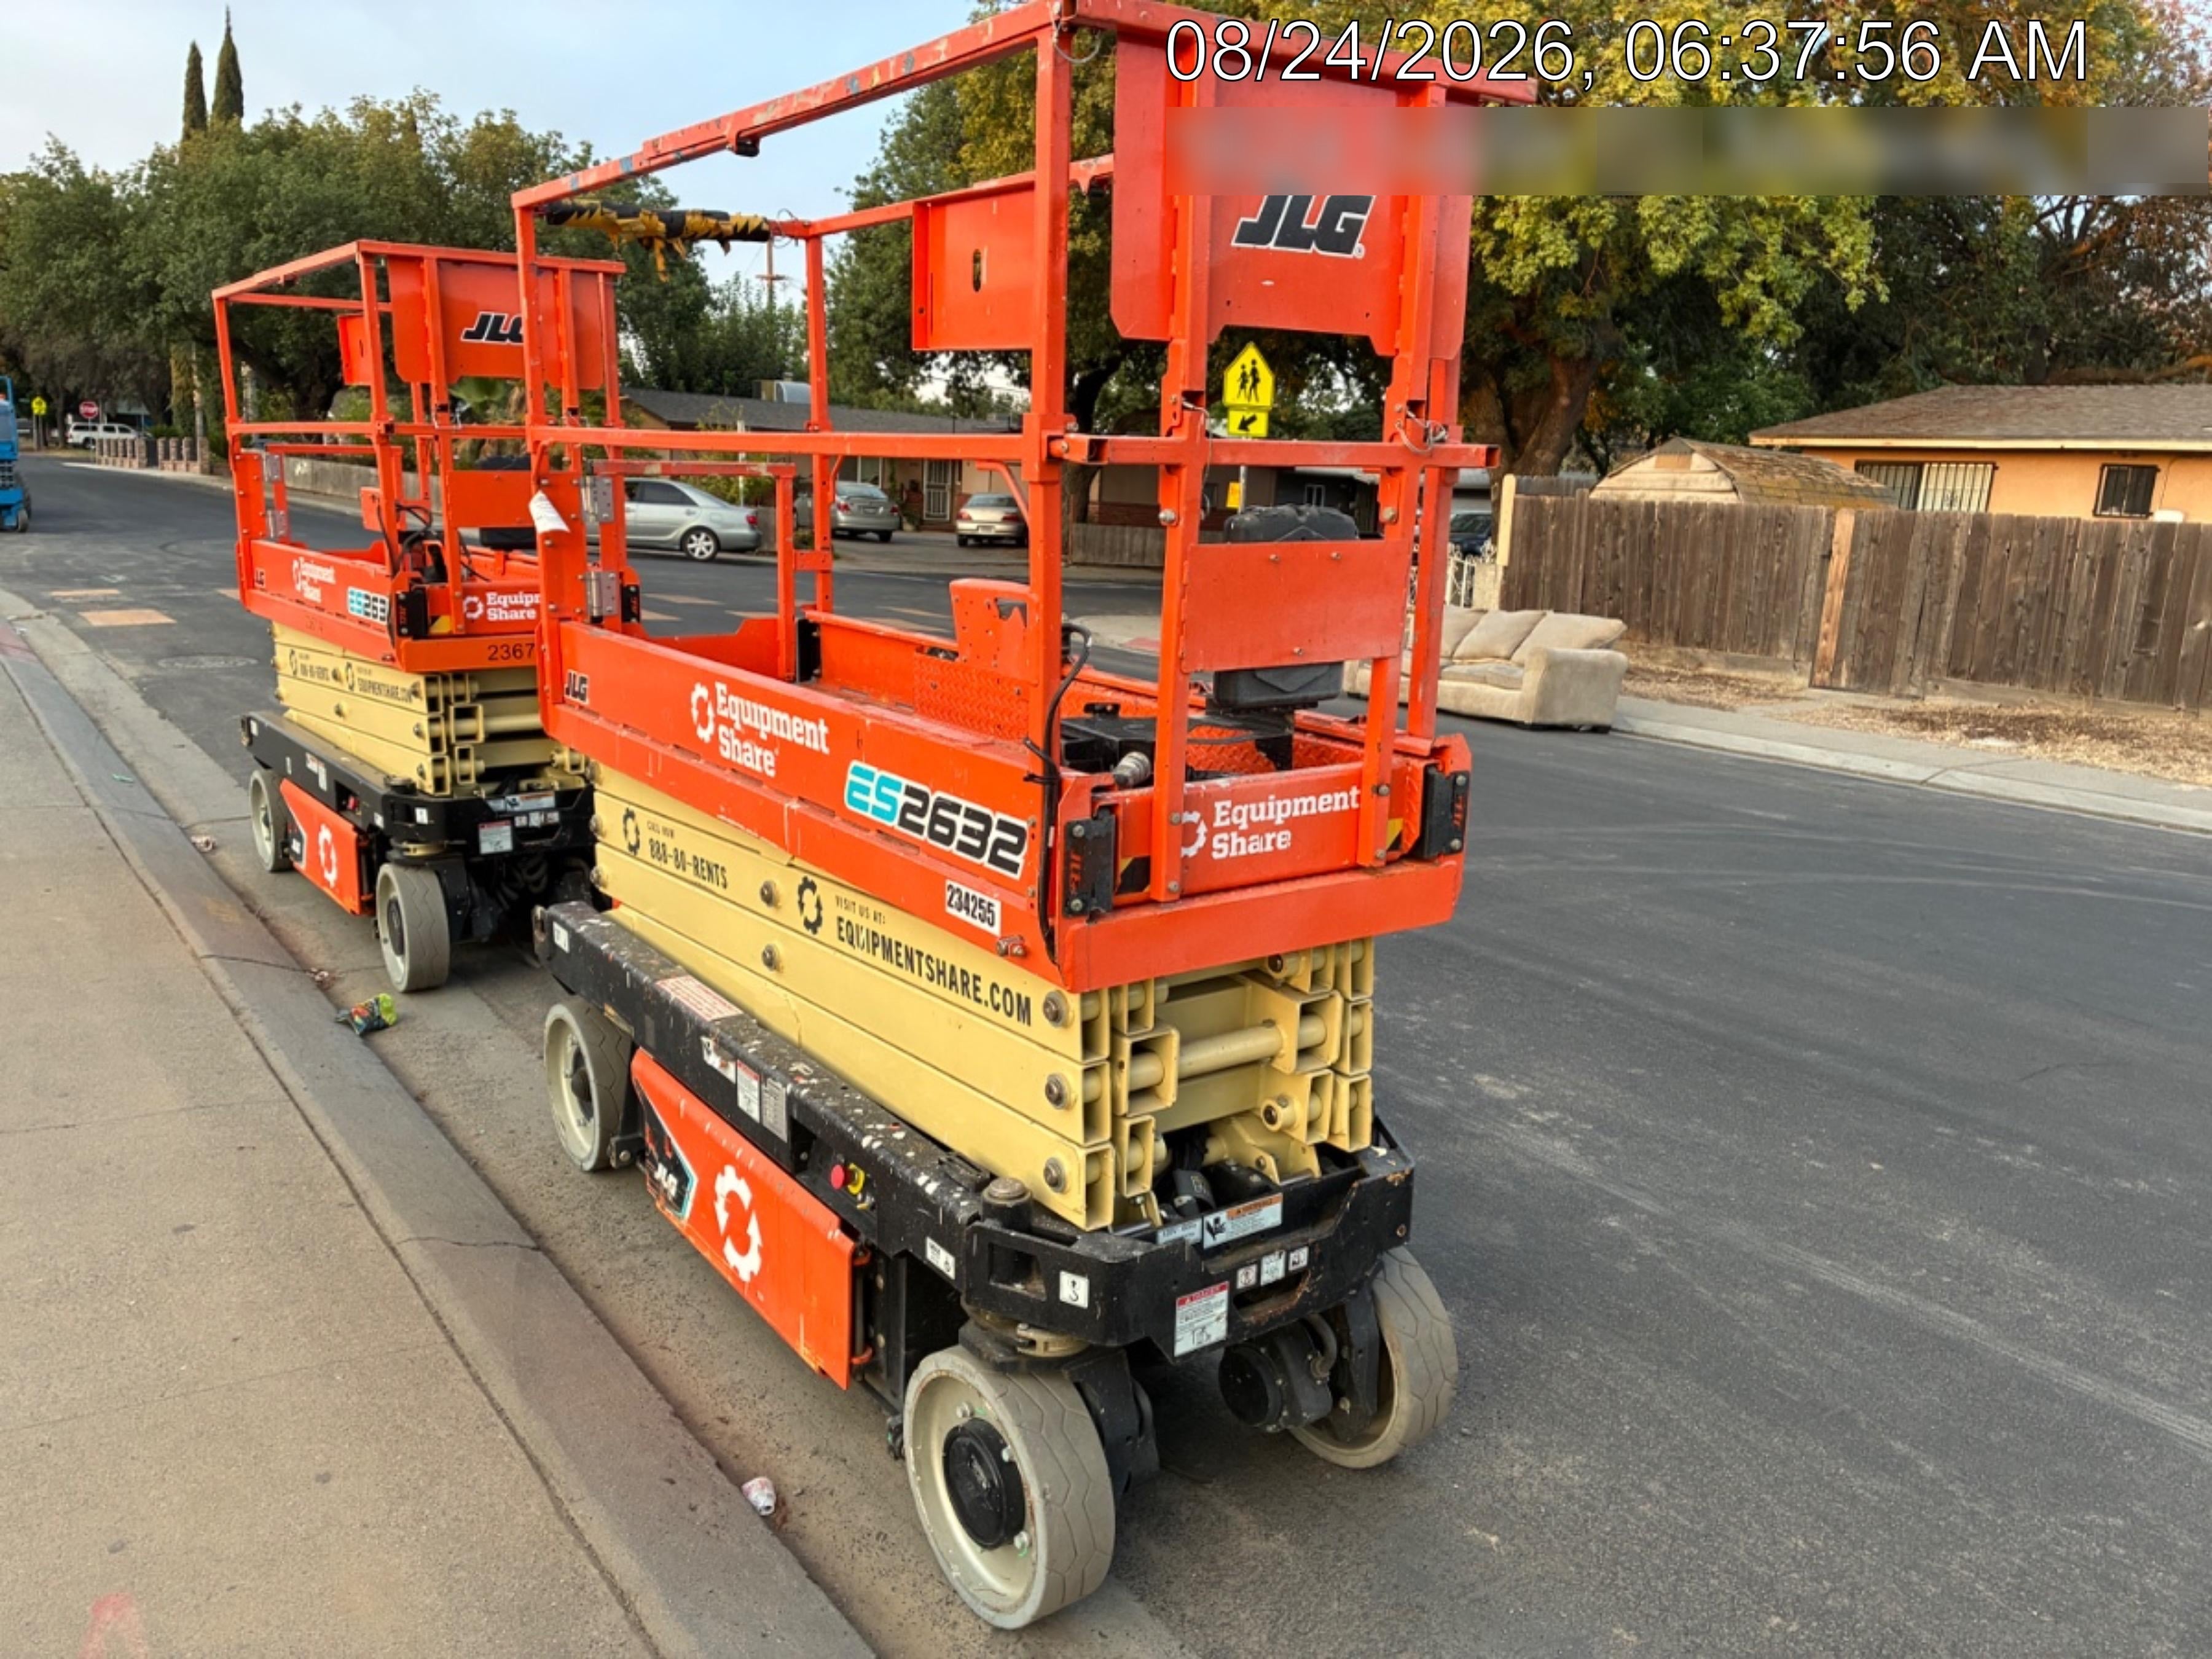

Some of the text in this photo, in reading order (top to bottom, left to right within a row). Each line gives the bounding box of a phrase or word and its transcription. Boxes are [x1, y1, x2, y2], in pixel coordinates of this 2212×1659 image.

[1231, 194, 1376, 258] JLG
[485, 607, 536, 621] Share
[488, 643, 535, 660] 2367
[564, 670, 589, 704] JLG
[715, 681, 830, 755] Equipment
[718, 724, 776, 779] Share
[845, 762, 1028, 877] ES2632
[1212, 785, 1360, 830] Equipment
[649, 837, 728, 890] 888-80-RENTS
[1212, 830, 1292, 860] Share
[834, 895, 886, 925] VISIT US AT:
[946, 884, 996, 928] 234255
[836, 916, 1032, 1027] EQUIPMENTSHARE.COM
